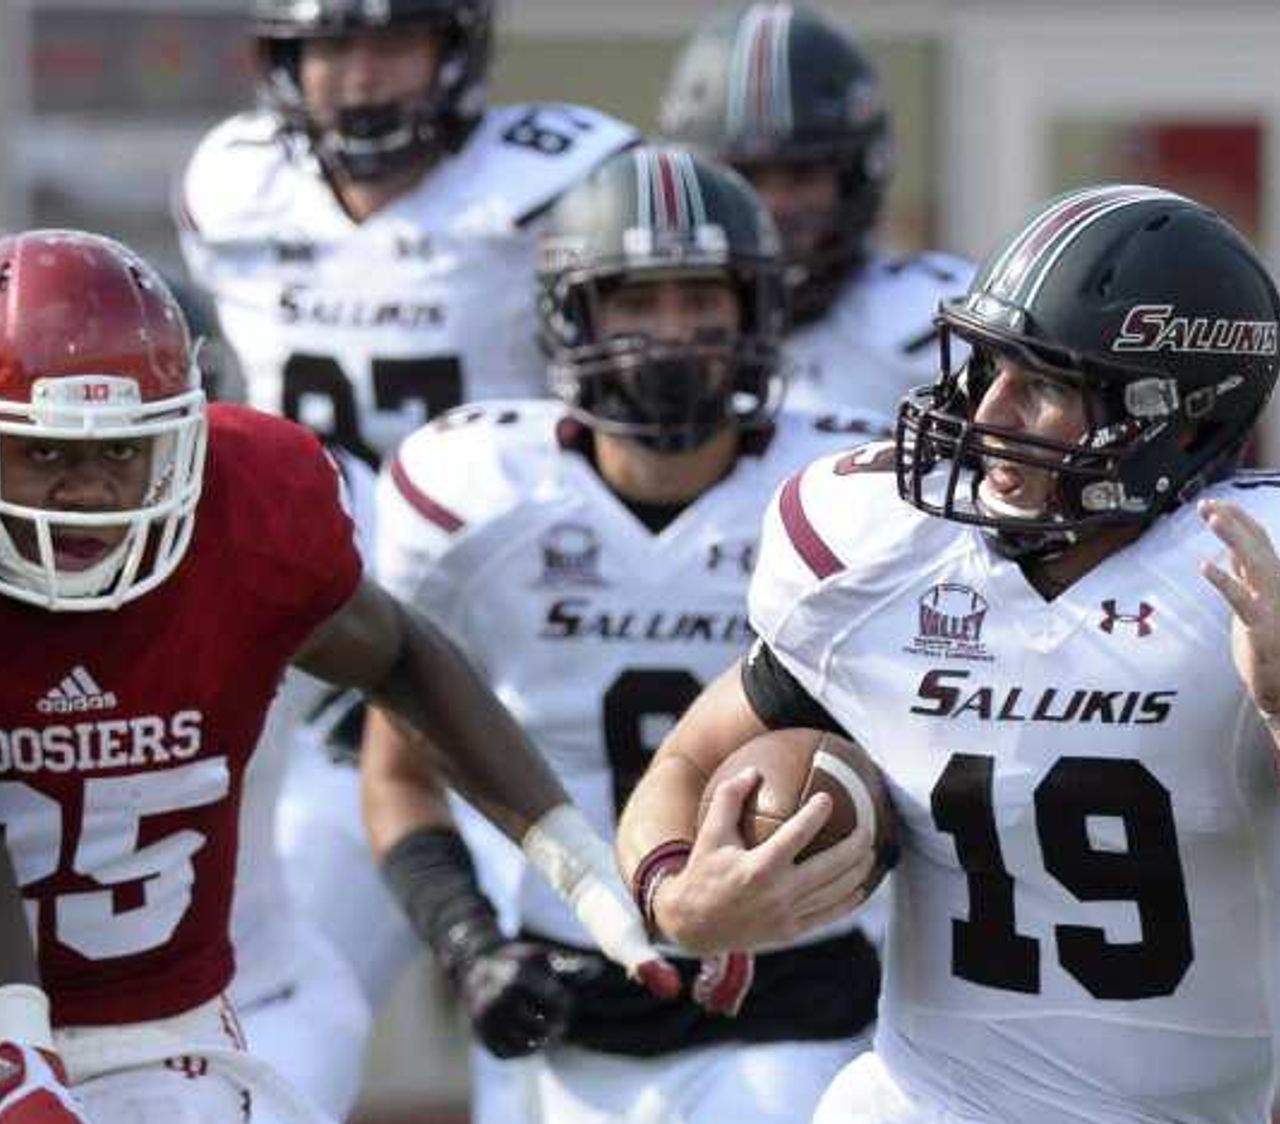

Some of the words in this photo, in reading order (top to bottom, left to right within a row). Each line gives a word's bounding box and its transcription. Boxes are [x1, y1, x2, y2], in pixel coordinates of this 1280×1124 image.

[1111, 304, 1278, 356] SALUKIS
[910, 668, 1179, 725] SALUKIS
[930, 752, 1195, 1001] 19
